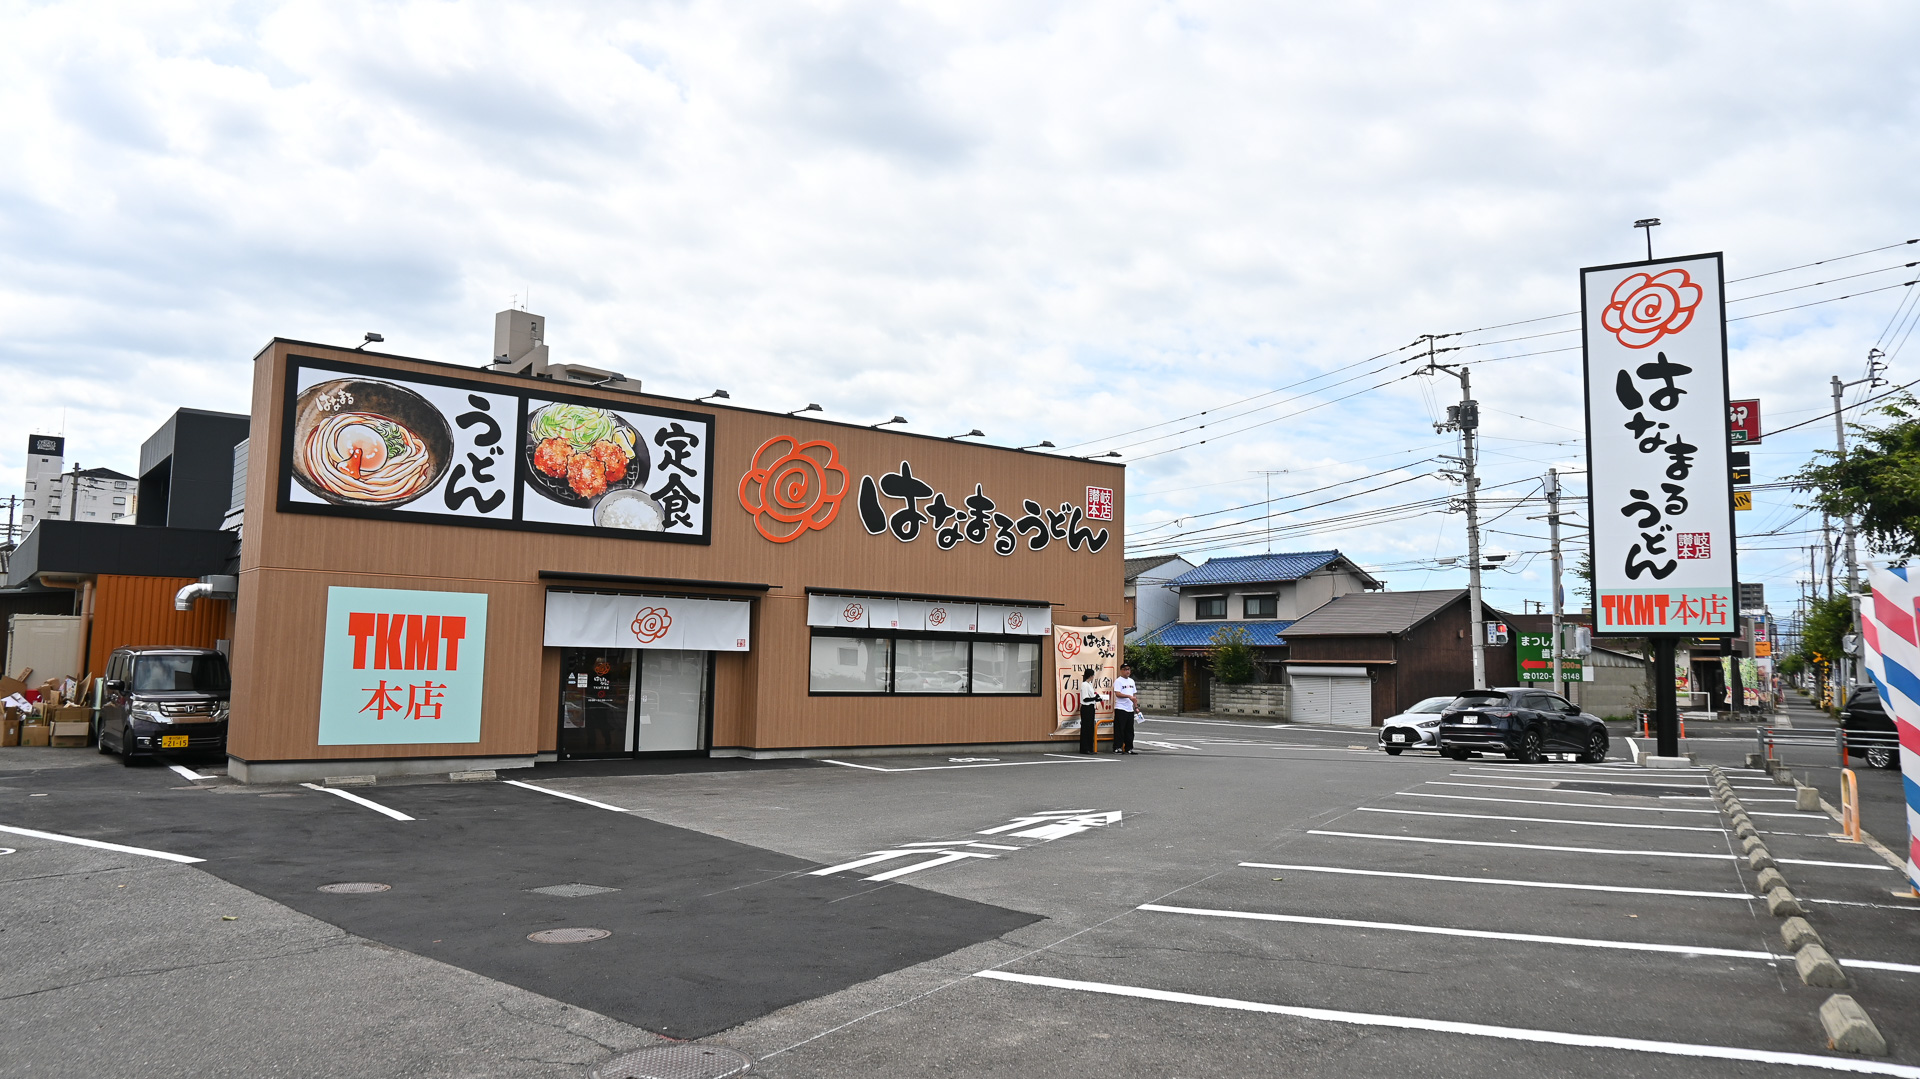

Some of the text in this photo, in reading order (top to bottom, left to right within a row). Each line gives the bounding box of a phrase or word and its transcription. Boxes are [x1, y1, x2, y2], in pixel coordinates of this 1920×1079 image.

[315, 389, 354, 412] はなまる
[1616, 352, 1698, 516] はなまる
[444, 394, 505, 514] うどん
[650, 422, 701, 529] 定食
[857, 460, 1109, 557] はなまるうどん
[1621, 489, 1678, 580] うどん
[348, 612, 466, 671] TKMT
[1601, 593, 1728, 626] TKMT本店
[359, 680, 447, 721] 本店
